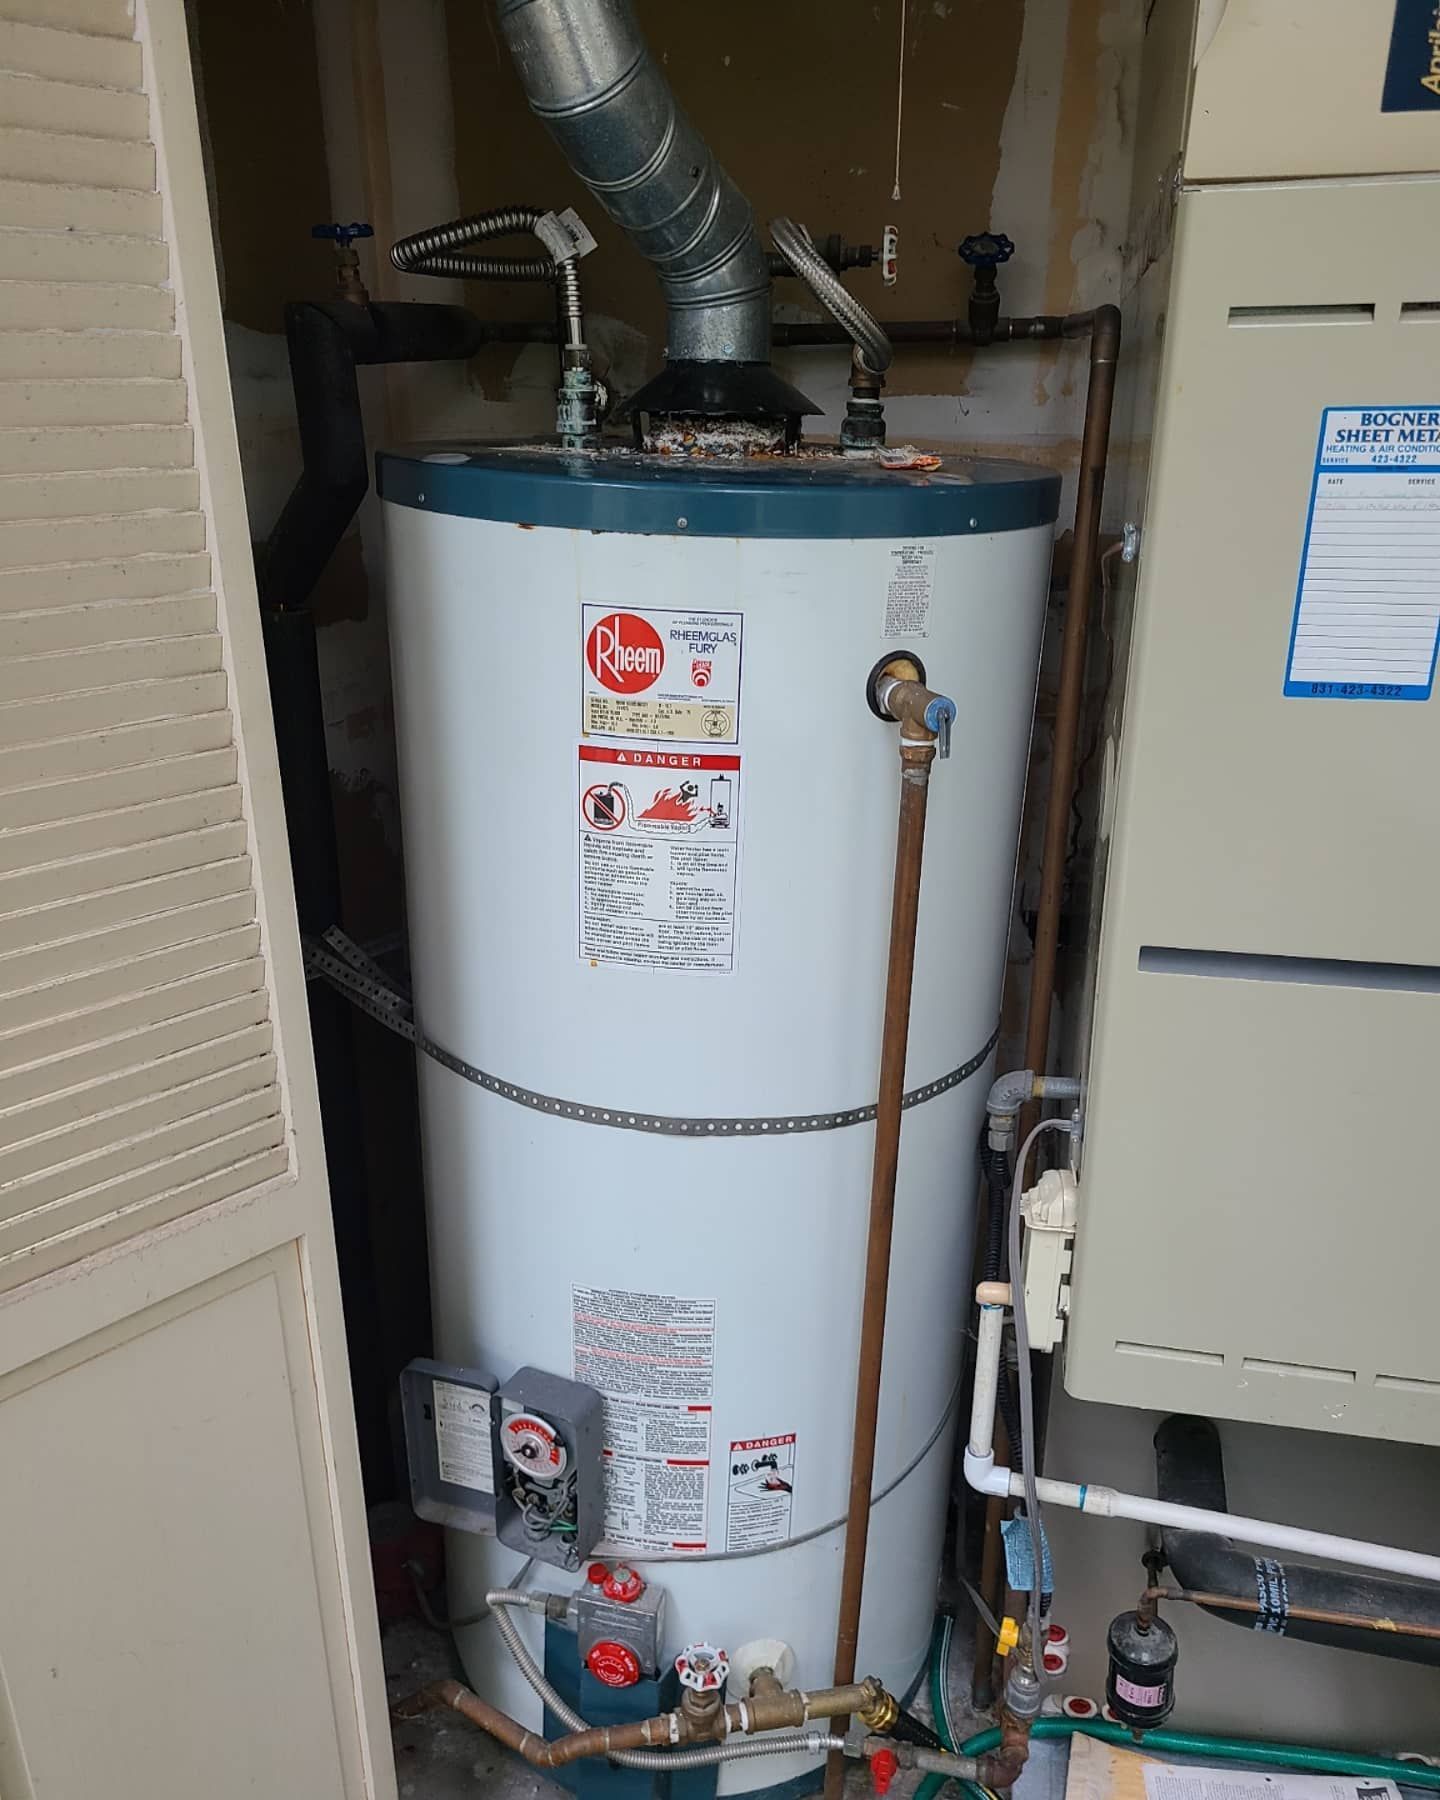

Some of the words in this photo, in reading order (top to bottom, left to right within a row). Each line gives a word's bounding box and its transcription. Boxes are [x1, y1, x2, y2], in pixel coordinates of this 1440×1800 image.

[1360, 412, 1440, 427] BOGNER
[1334, 428, 1394, 443] SHEET
[1326, 444, 1367, 454] HEATING
[1369, 444, 1376, 453] &
[1378, 444, 1395, 453] AIR
[670, 629, 737, 643] RHEEMGLAS
[596, 615, 661, 683] Rheem
[689, 643, 718, 654] FURY
[633, 752, 702, 767] DANGER
[746, 1436, 793, 1449] DANGER
